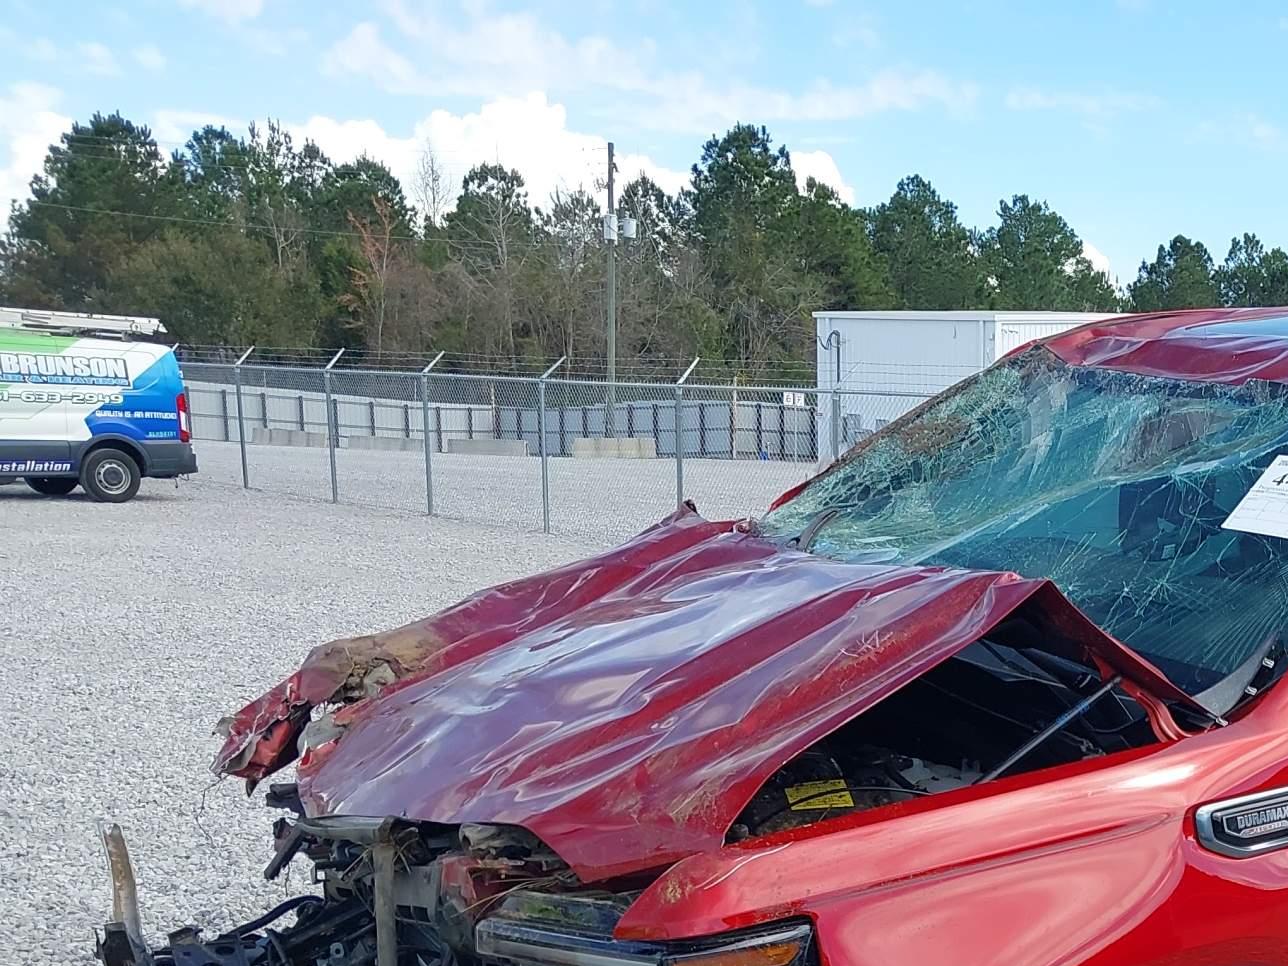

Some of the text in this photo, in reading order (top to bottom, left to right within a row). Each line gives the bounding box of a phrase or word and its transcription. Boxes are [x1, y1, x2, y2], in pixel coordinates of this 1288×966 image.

[1, 353, 127, 378] BRUNSON
[0, 390, 124, 404] 1-633-2949
[124, 410, 131, 418] IS
